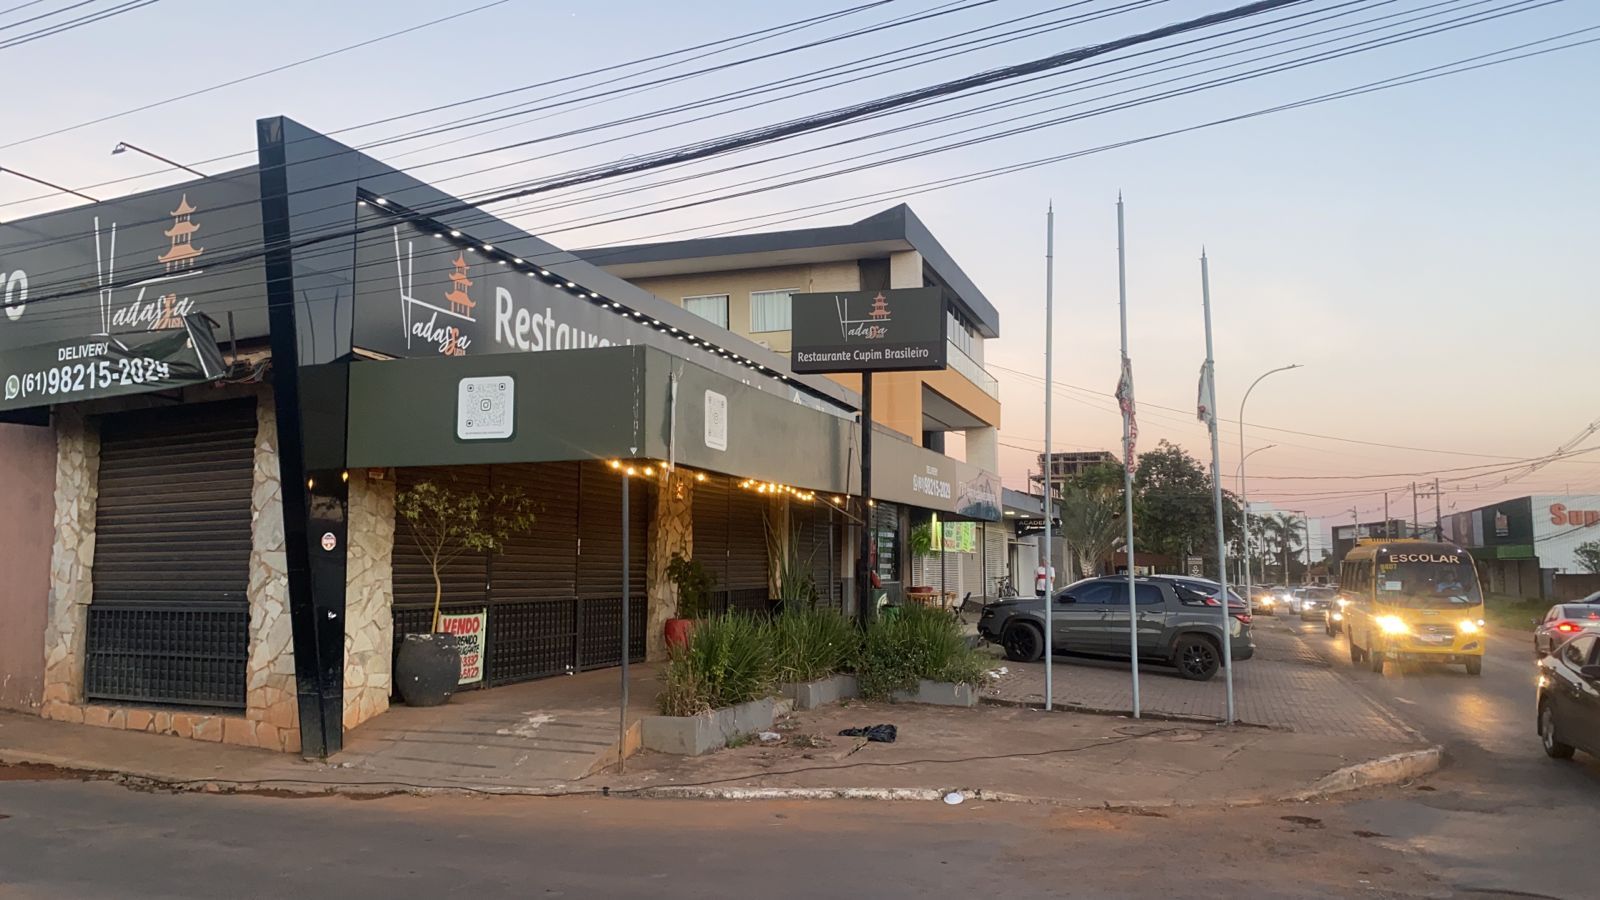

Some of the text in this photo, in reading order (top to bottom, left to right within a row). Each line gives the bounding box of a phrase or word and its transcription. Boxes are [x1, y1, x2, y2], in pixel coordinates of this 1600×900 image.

[58, 342, 109, 361] DELIVERY
[798, 347, 929, 362] Restaurante Cupim Brasileiro
[1389, 553, 1460, 564] ESCOLAR
[443, 616, 480, 635] VENDO
